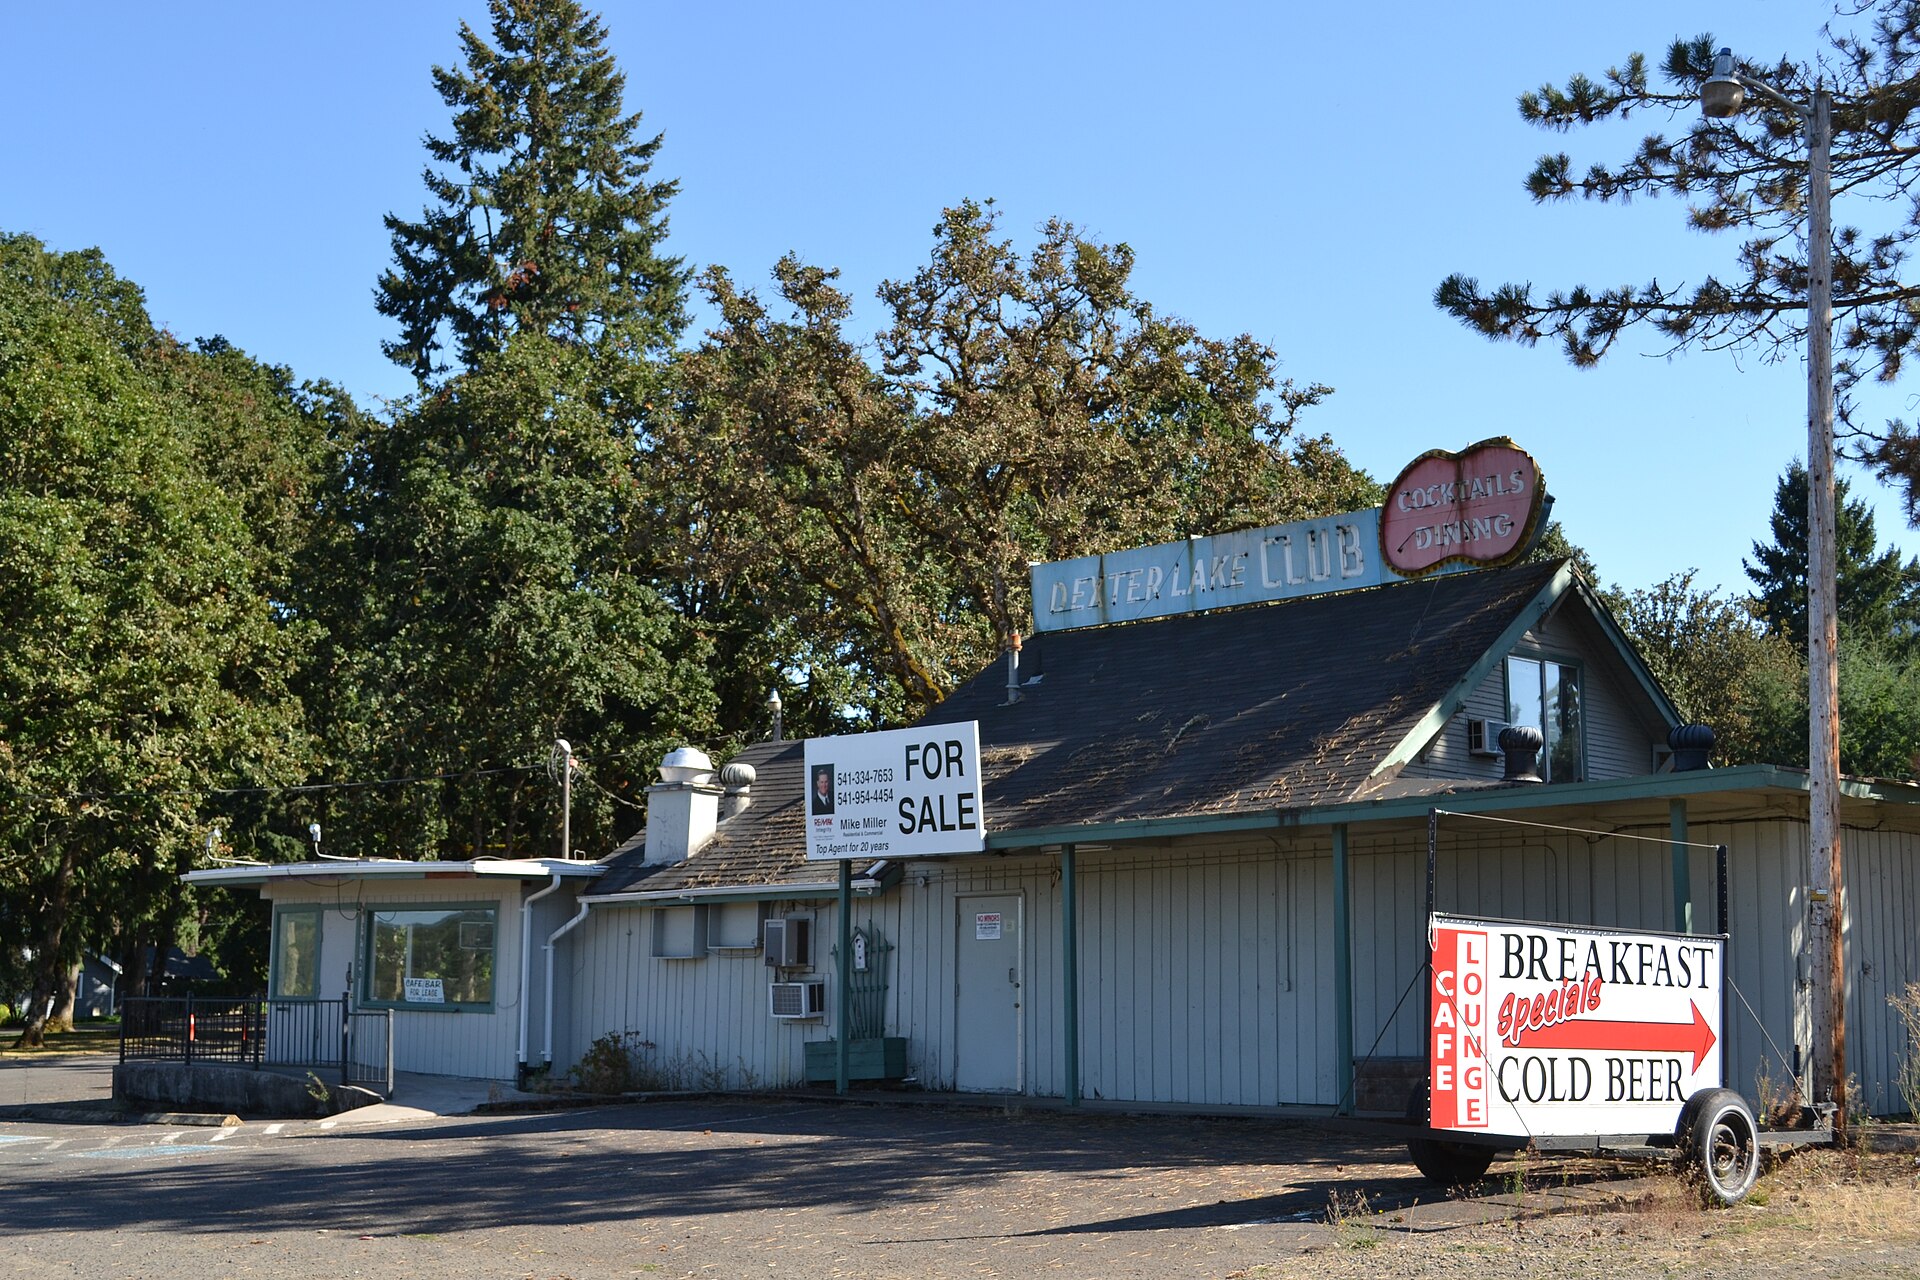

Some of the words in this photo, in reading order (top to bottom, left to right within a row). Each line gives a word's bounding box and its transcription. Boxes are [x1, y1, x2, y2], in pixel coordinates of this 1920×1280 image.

[1397, 468, 1525, 513] COCKTAILS
[1414, 513, 1514, 550] DINING
[1050, 567, 1164, 614] DEXTER
[1170, 551, 1249, 597] LAKE
[1261, 524, 1365, 589] CLUB
[837, 768, 893, 786] 541-334-7653
[905, 739, 964, 782] FOR
[837, 788, 894, 806] 541-954-4454
[898, 792, 976, 835] SALE
[813, 817, 834, 826] RE/MAX
[840, 818, 860, 830] Mike
[862, 816, 887, 829] Miller
[816, 844, 827, 856] Top
[828, 843, 848, 855] Agent
[849, 842, 859, 852] for
[860, 841, 869, 852] 20
[870, 842, 889, 853] years
[1499, 932, 1714, 990] BREAKFAST
[410, 988, 420, 996] FOR
[421, 988, 438, 997] LEASE
[1497, 970, 1603, 1042] Specials
[1432, 970, 1456, 1092] CAFE
[1462, 940, 1483, 1122] LOUNGE
[1498, 1056, 1592, 1104] COLD
[1604, 1057, 1689, 1103] BEER
